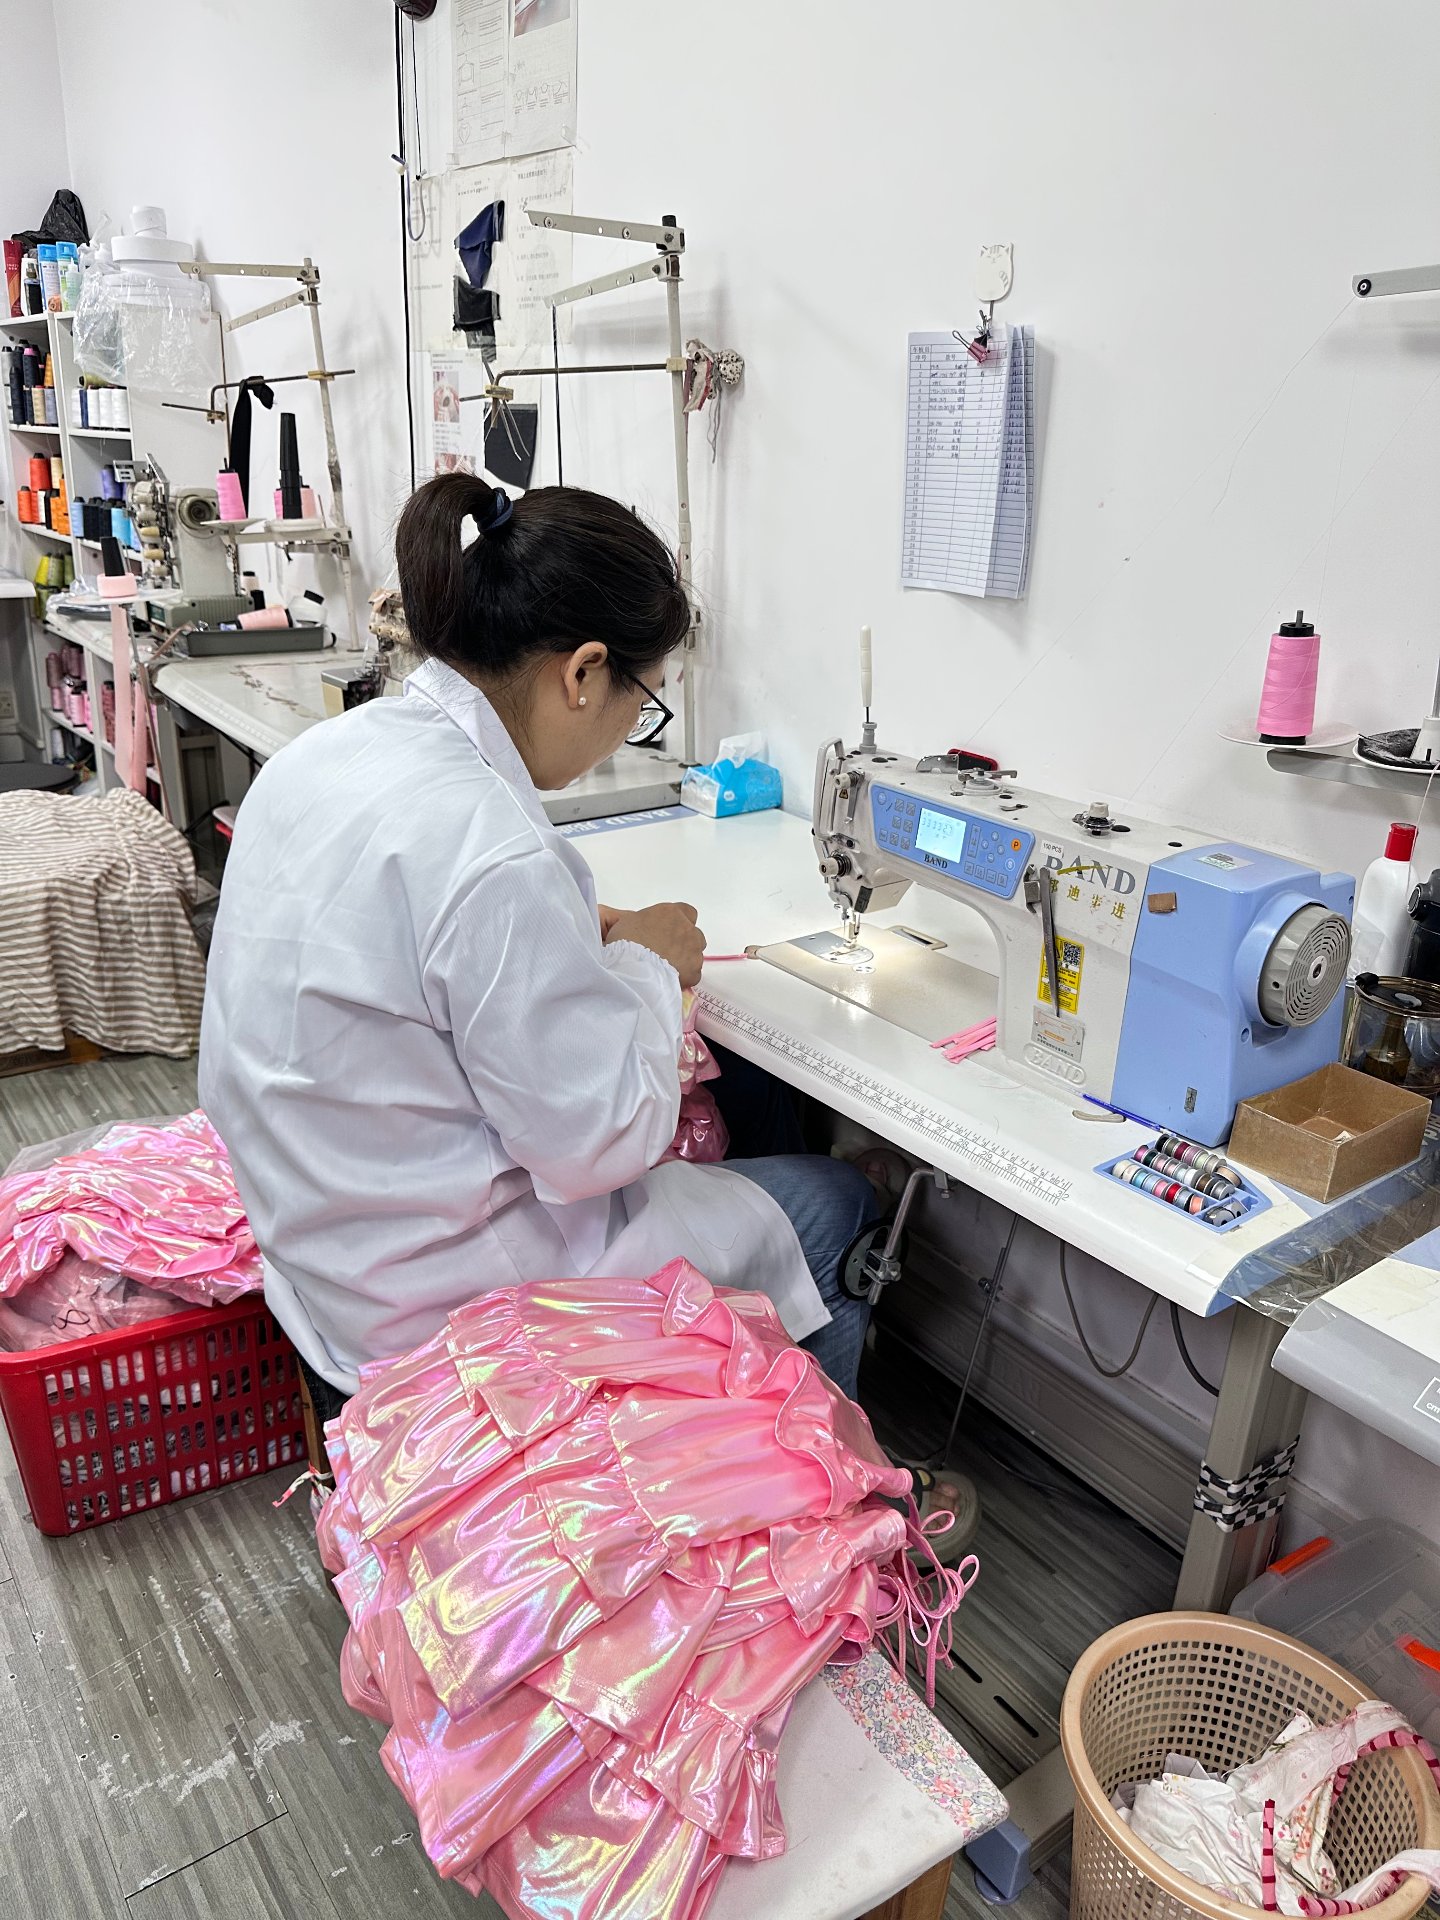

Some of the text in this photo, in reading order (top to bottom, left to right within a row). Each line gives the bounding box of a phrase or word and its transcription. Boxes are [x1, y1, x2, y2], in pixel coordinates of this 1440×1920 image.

[1051, 845, 1062, 854] PCS
[923, 854, 948, 869] BAND
[891, 1103, 903, 1113] 25
[913, 1114, 924, 1125] 26
[935, 1126, 947, 1136] 27
[957, 1138, 969, 1149] 28
[979, 1150, 993, 1161] 29
[1005, 1163, 1018, 1174] 30
[1030, 1176, 1043, 1187] 31
[1055, 1190, 1070, 1201] 32
